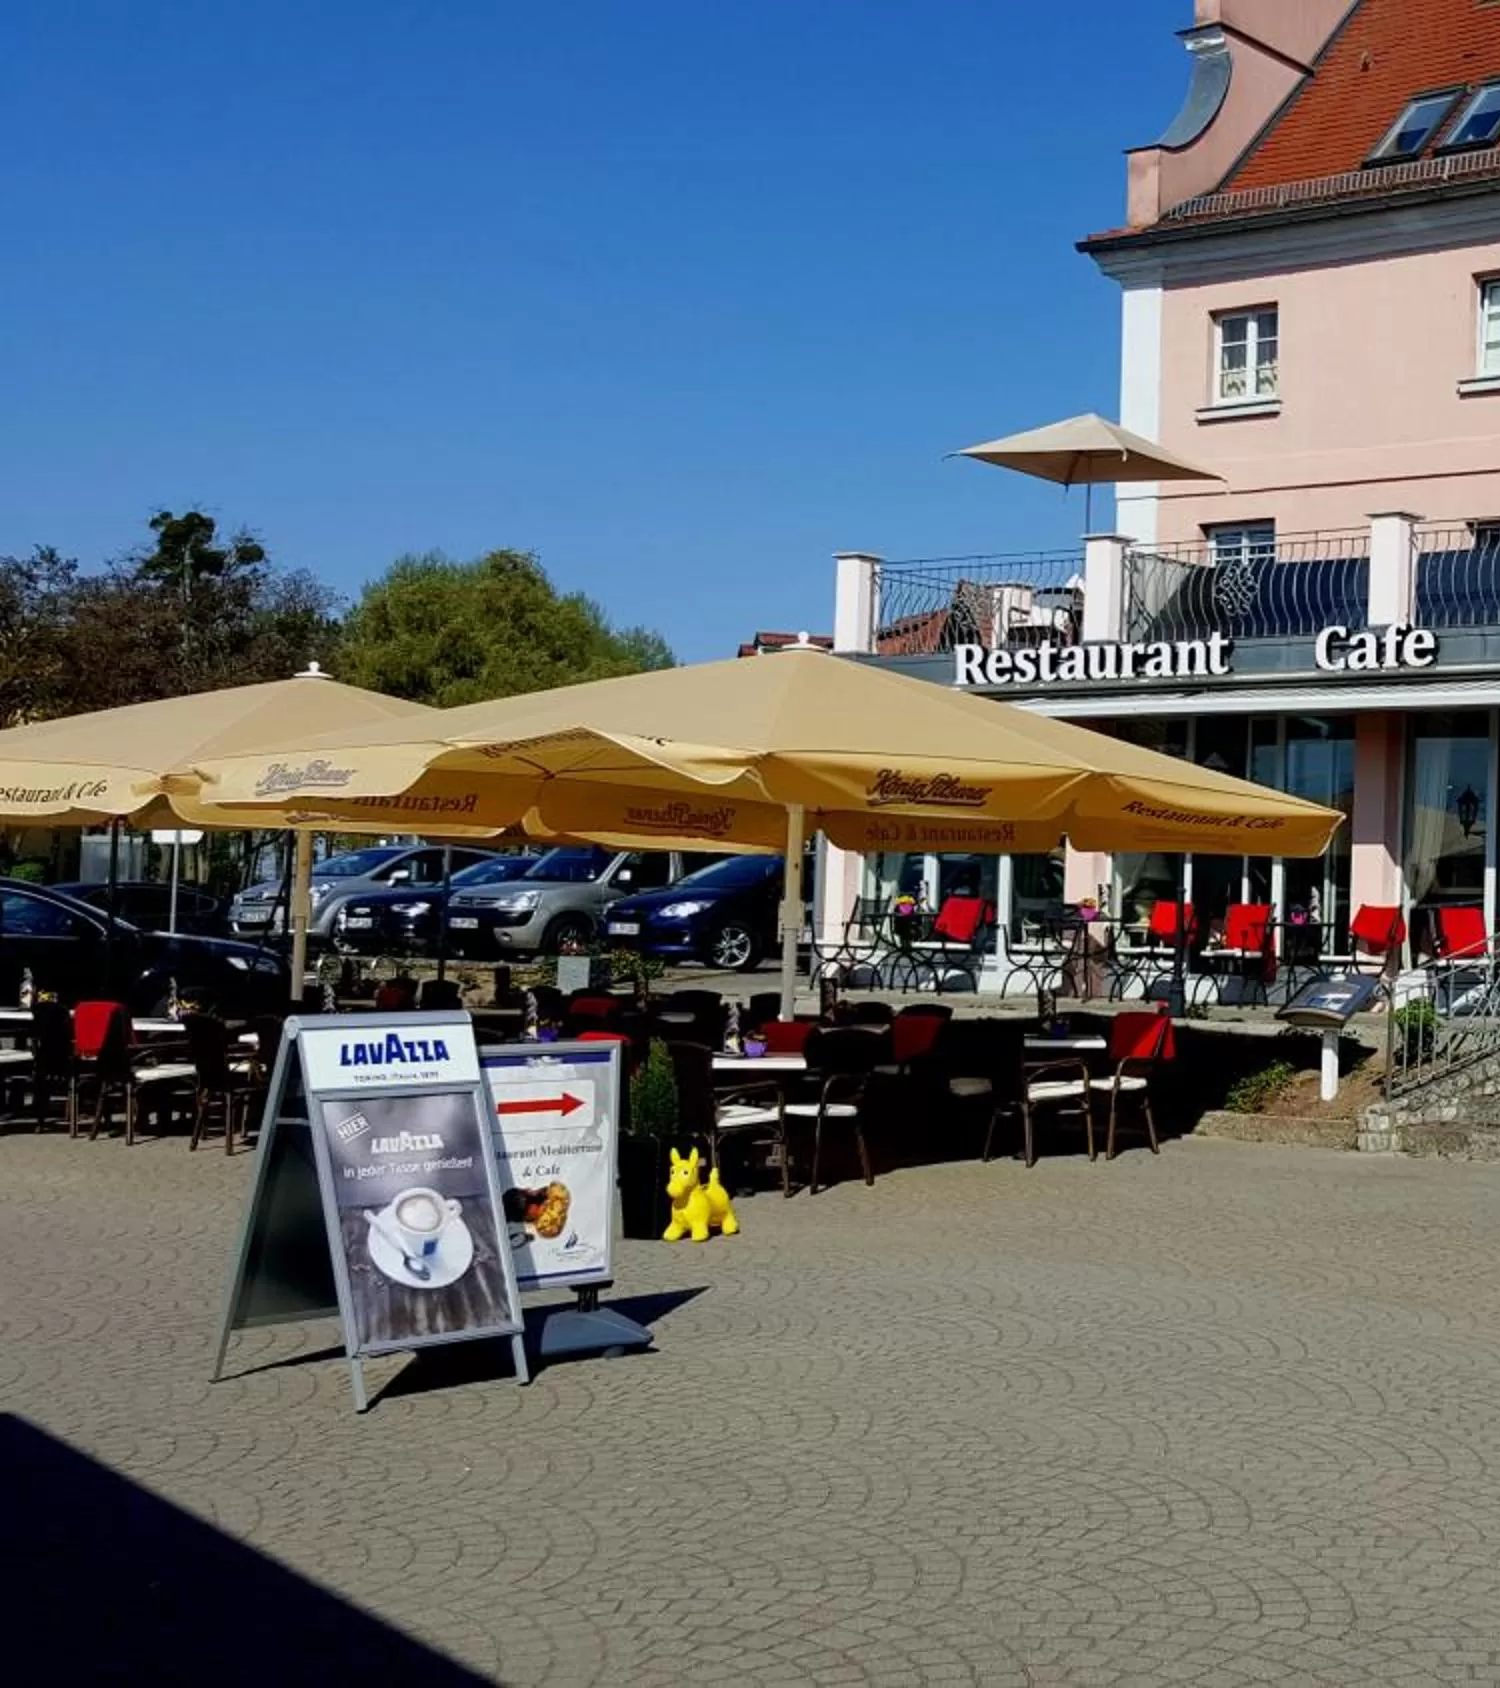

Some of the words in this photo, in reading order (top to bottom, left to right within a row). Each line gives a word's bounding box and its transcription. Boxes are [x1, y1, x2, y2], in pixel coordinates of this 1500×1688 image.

[954, 631, 1232, 685] Restaurant
[0, 787, 64, 803] estaurant
[339, 1033, 449, 1066] LAVAZZA
[337, 1114, 370, 1139] HIER
[371, 1131, 444, 1153] LAVAZZA
